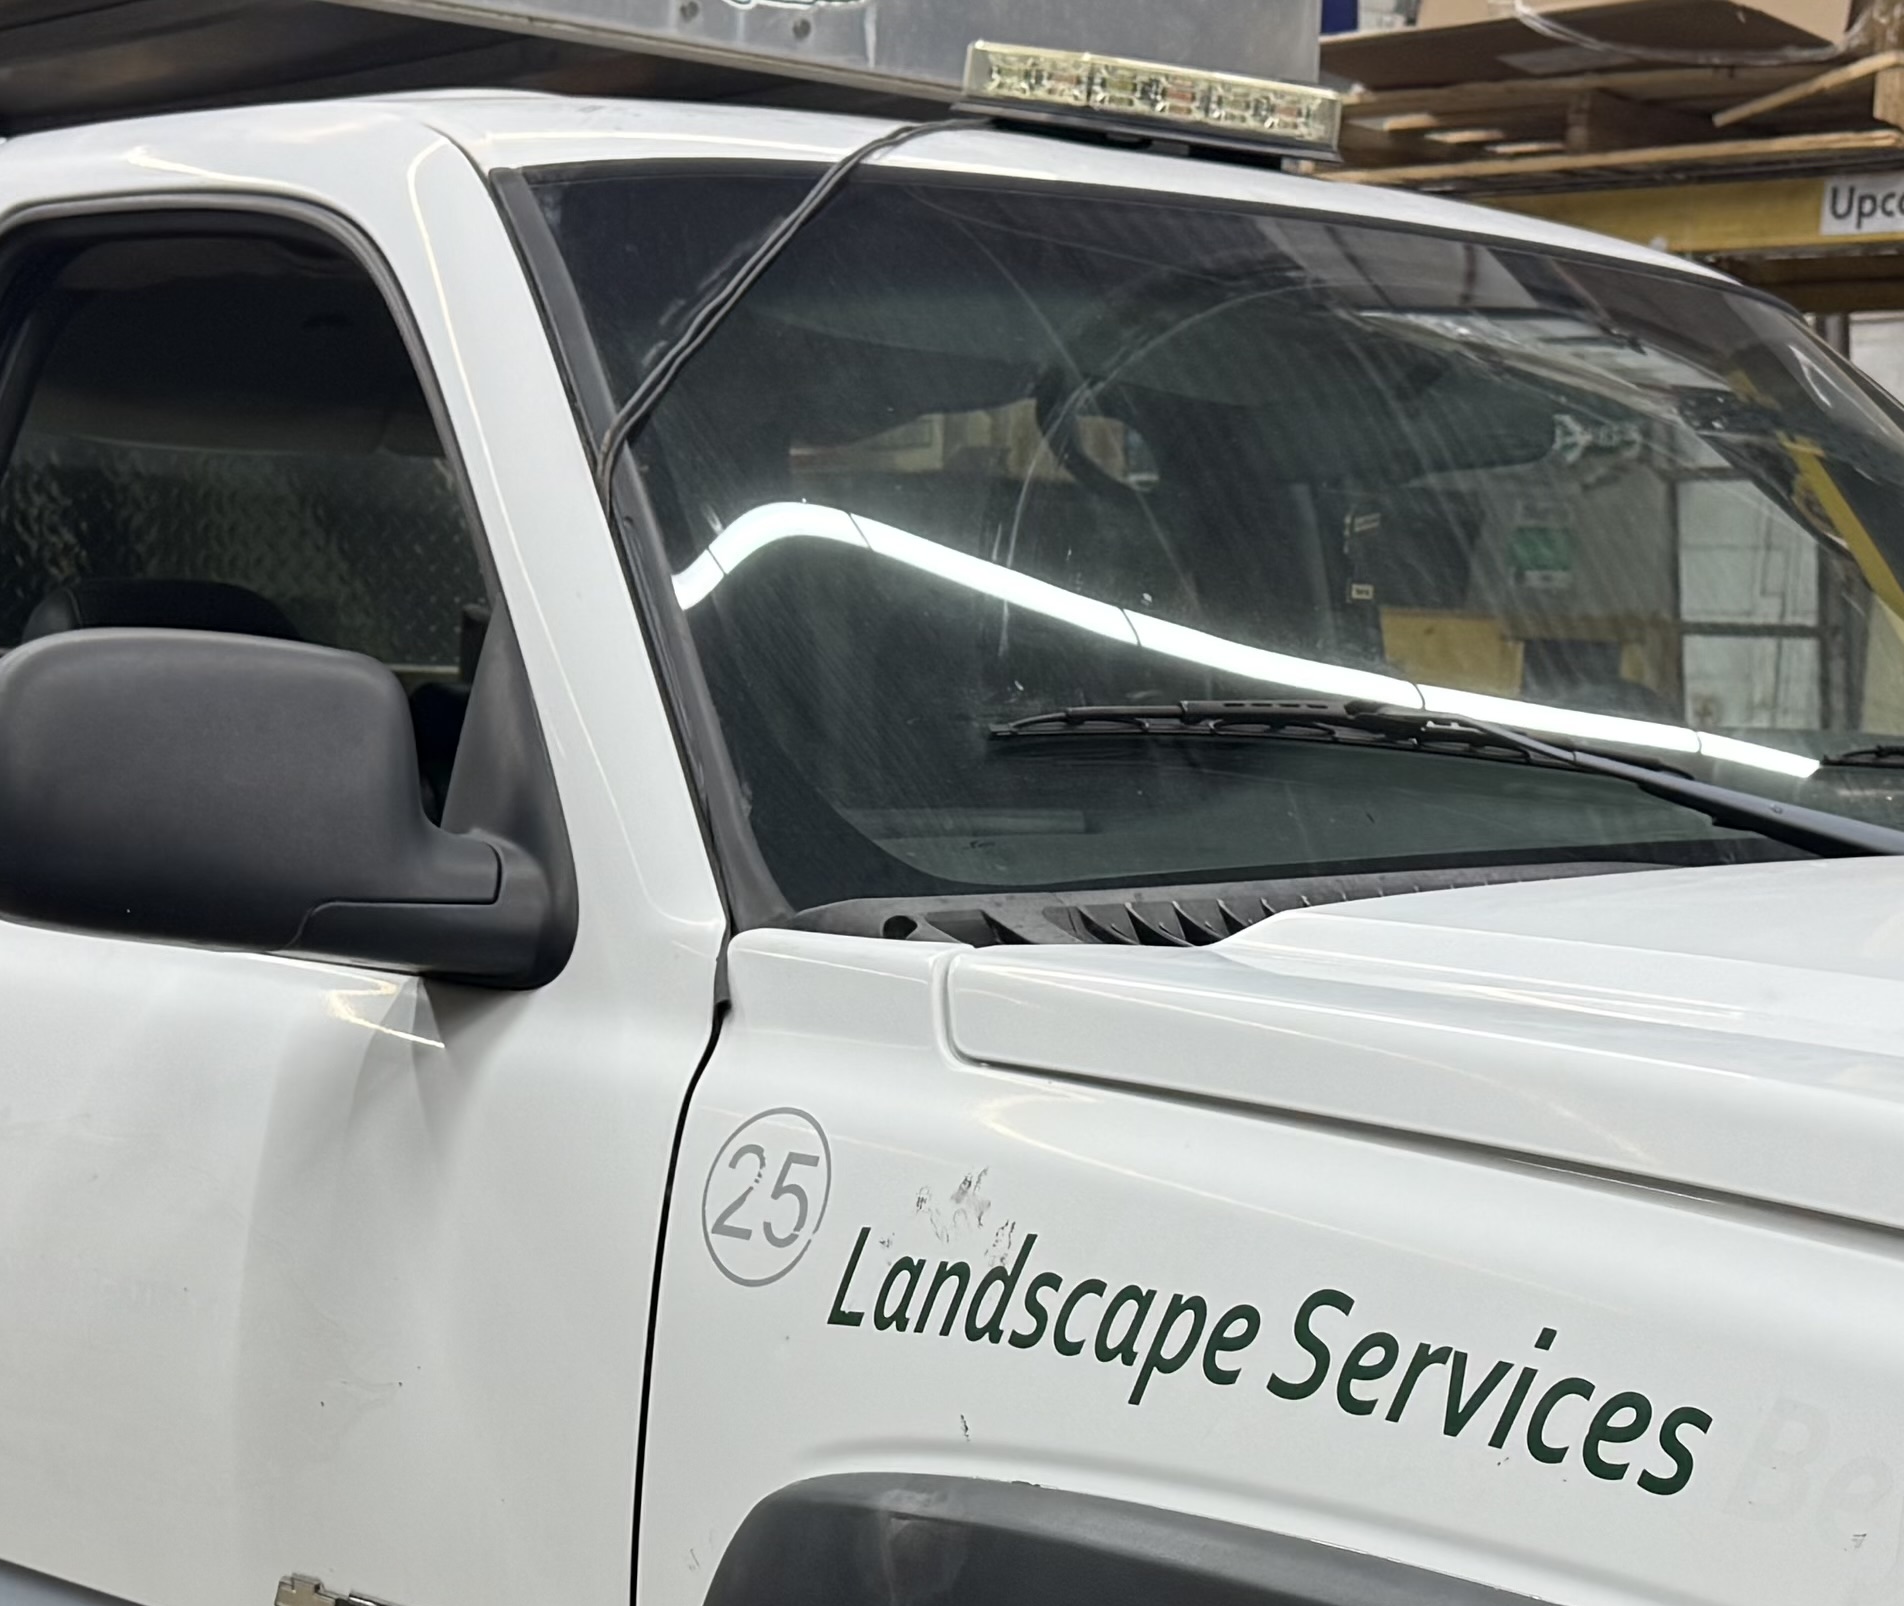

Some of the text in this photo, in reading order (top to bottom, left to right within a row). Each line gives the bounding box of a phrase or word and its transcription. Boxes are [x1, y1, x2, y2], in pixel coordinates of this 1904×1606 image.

[709, 1140, 820, 1249] 25
[827, 1225, 1714, 1496] Landscape Services
